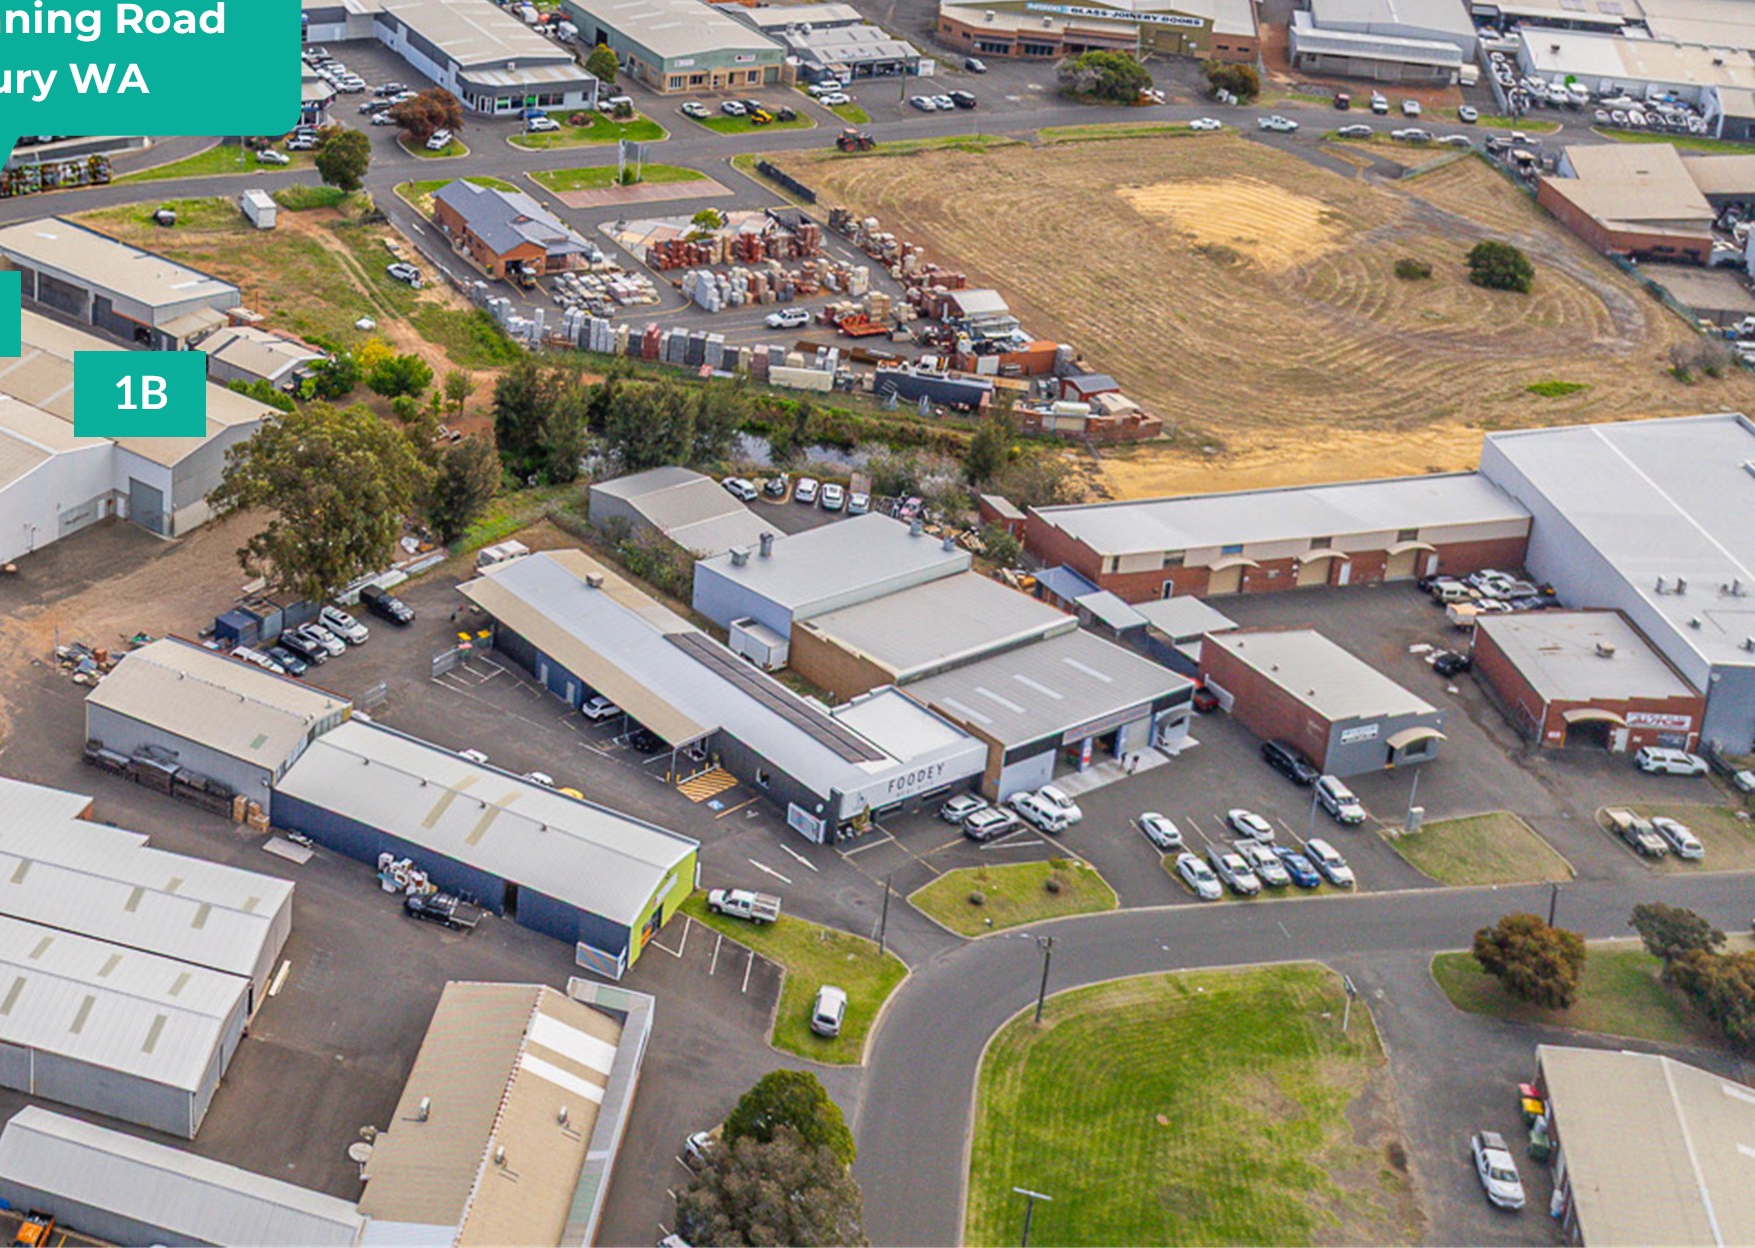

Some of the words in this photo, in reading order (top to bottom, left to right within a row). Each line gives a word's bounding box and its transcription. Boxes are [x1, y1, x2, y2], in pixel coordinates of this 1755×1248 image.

[1070, 7, 1107, 17] GLASS
[1161, 17, 1201, 26] DOORS
[888, 762, 945, 793] FOODEY
